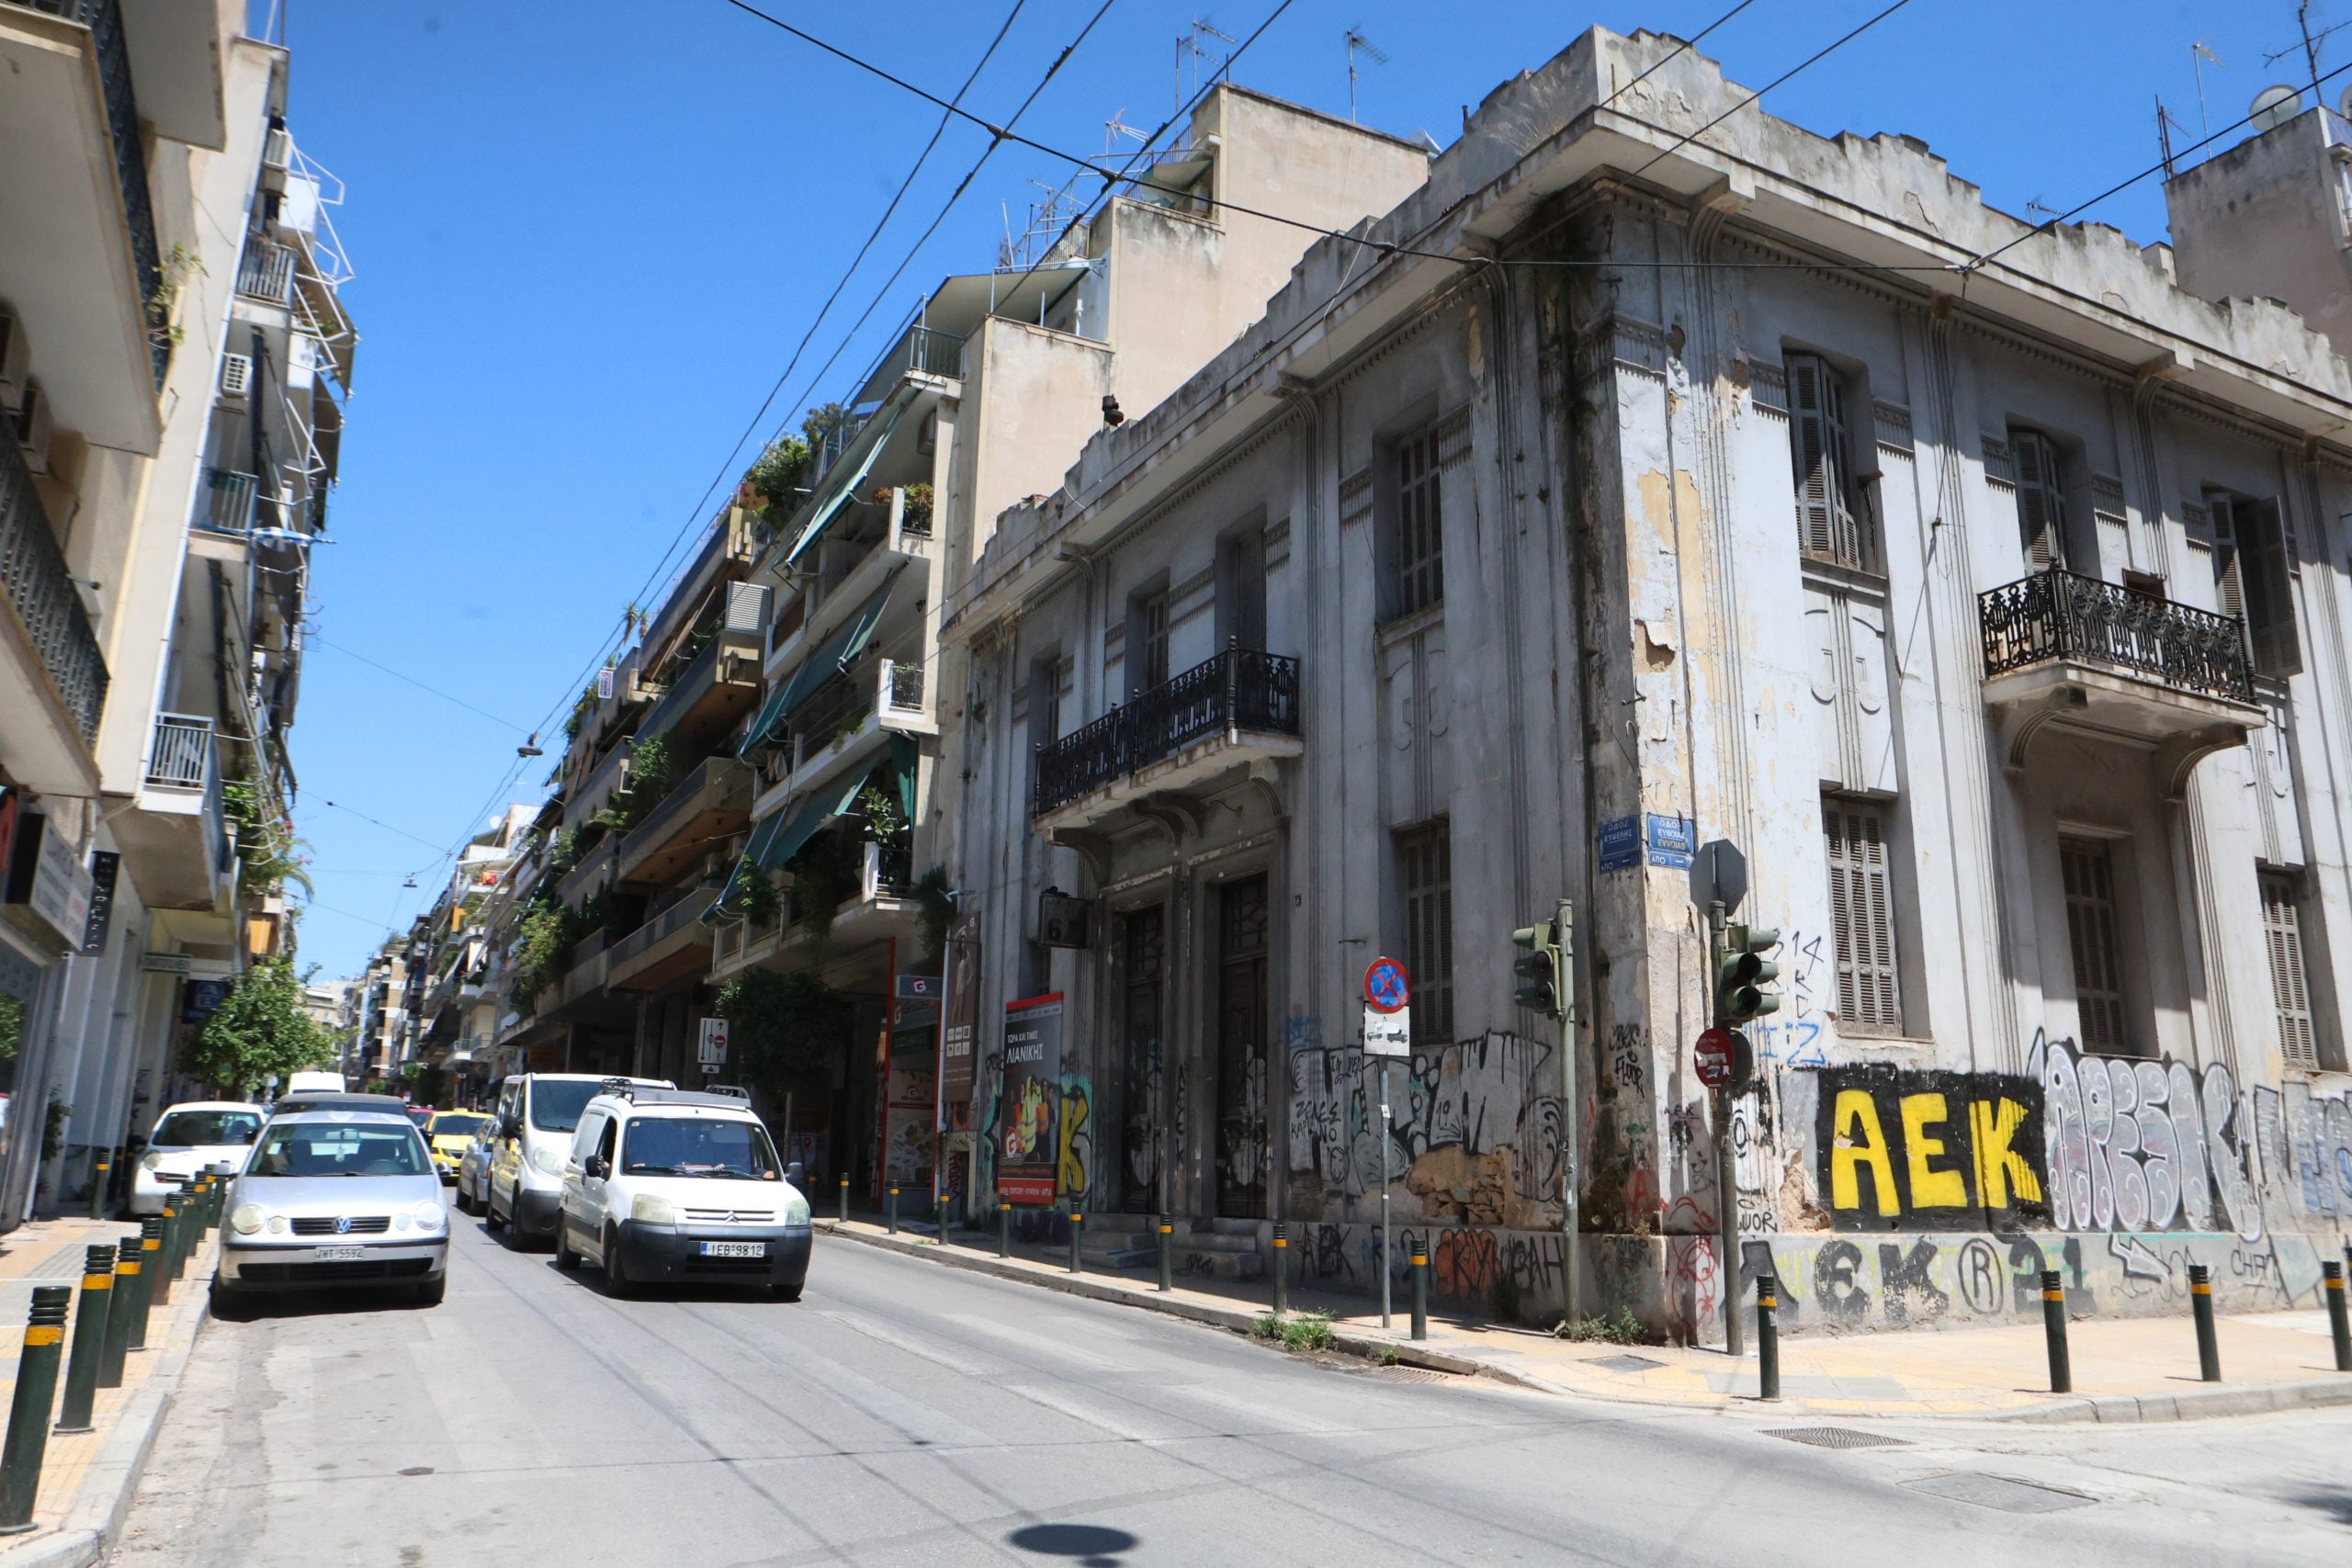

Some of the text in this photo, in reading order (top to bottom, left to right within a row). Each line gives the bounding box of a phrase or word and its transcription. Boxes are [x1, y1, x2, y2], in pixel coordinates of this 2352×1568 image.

[1604, 829, 1633, 843] ΚΥΨΕΛΗΣ
[1007, 1043, 1044, 1064] ΛΙΑΝΙΚΗΣ
[1832, 1089, 2043, 1217] ΑΕΚ
